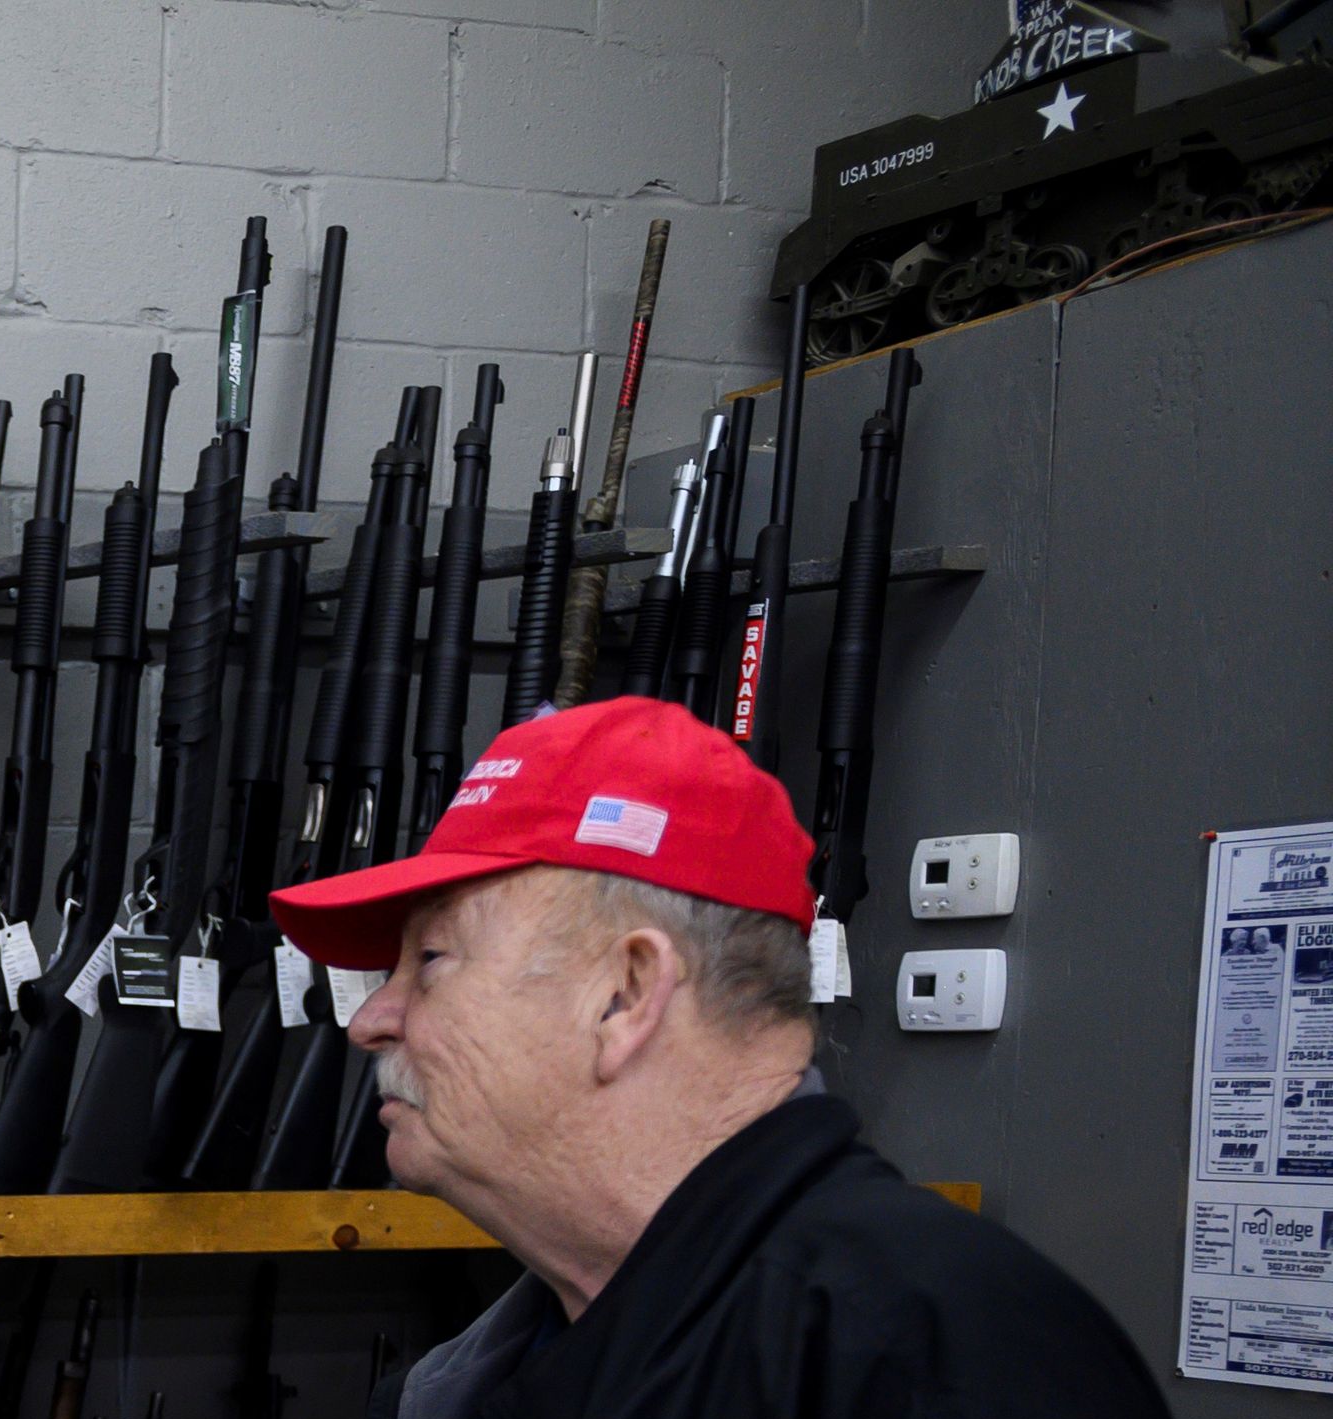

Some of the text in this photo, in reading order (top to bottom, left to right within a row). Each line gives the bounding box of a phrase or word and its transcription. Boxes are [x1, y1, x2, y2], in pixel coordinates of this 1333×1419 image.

[1014, 9, 1063, 45] SPEAK
[974, 25, 1133, 104] KNOB CREEK
[840, 142, 934, 187] USA 3047999
[229, 342, 242, 385] M887
[735, 626, 760, 735] SAVAGE
[1241, 1218, 1314, 1242] red edge
